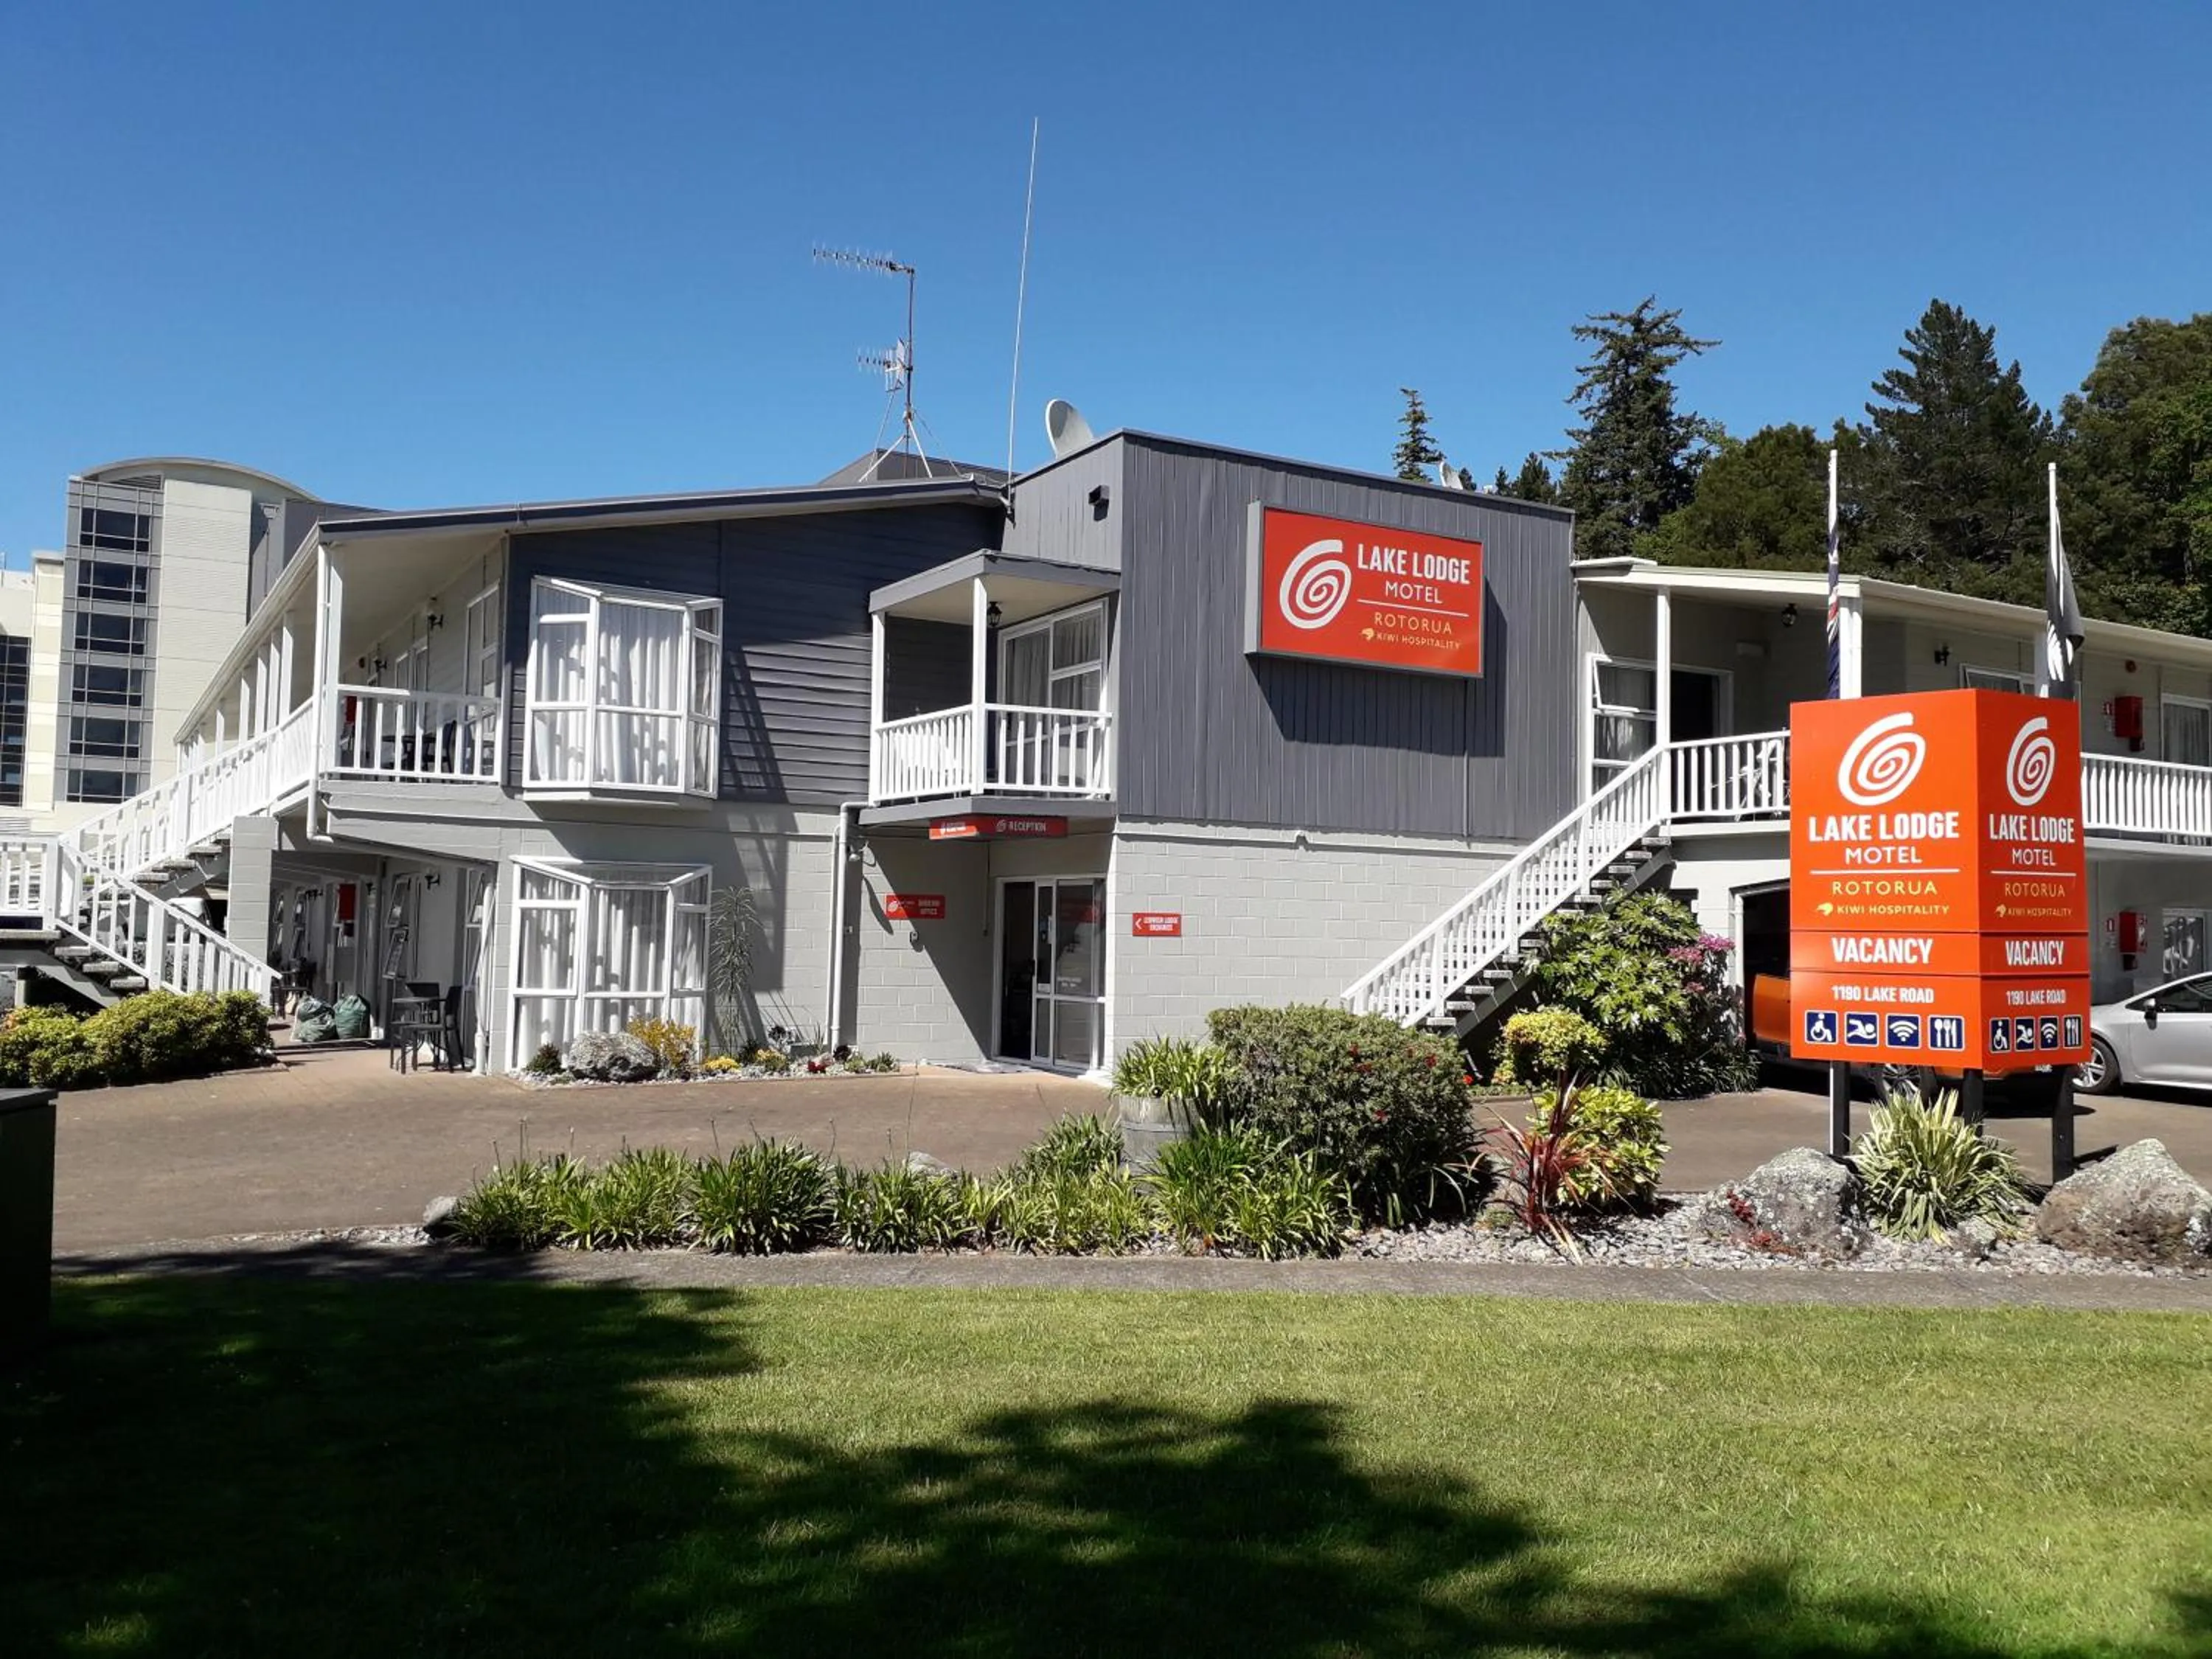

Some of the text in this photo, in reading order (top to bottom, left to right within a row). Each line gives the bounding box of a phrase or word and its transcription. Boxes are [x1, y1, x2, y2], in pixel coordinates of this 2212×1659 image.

[1357, 543, 1471, 585] LAKE LODGE
[1385, 580, 1443, 604] MOTEL
[1374, 612, 1452, 635] ROTORUA
[1377, 632, 1461, 650] KIWI HOSPITALITY
[1009, 822, 1046, 832] RECEPTION
[1809, 811, 1960, 842] LAKE LODGE
[1989, 813, 2076, 844] LAKE LODGE
[1845, 846, 1923, 864] MOTEL
[2011, 848, 2056, 866] MOTEL
[1832, 880, 1938, 895] ROTORUA
[2005, 883, 2065, 897] ROTORUA
[1837, 905, 1950, 914] KIWI HOSPITALITY
[1831, 936, 1933, 964] VACANCY
[2006, 940, 2064, 966] VACANCY
[1832, 985, 1934, 1004] 1190 LAKE ROAD
[2025, 990, 2045, 1005] LAKE
[2046, 990, 2066, 1004] ROAD
